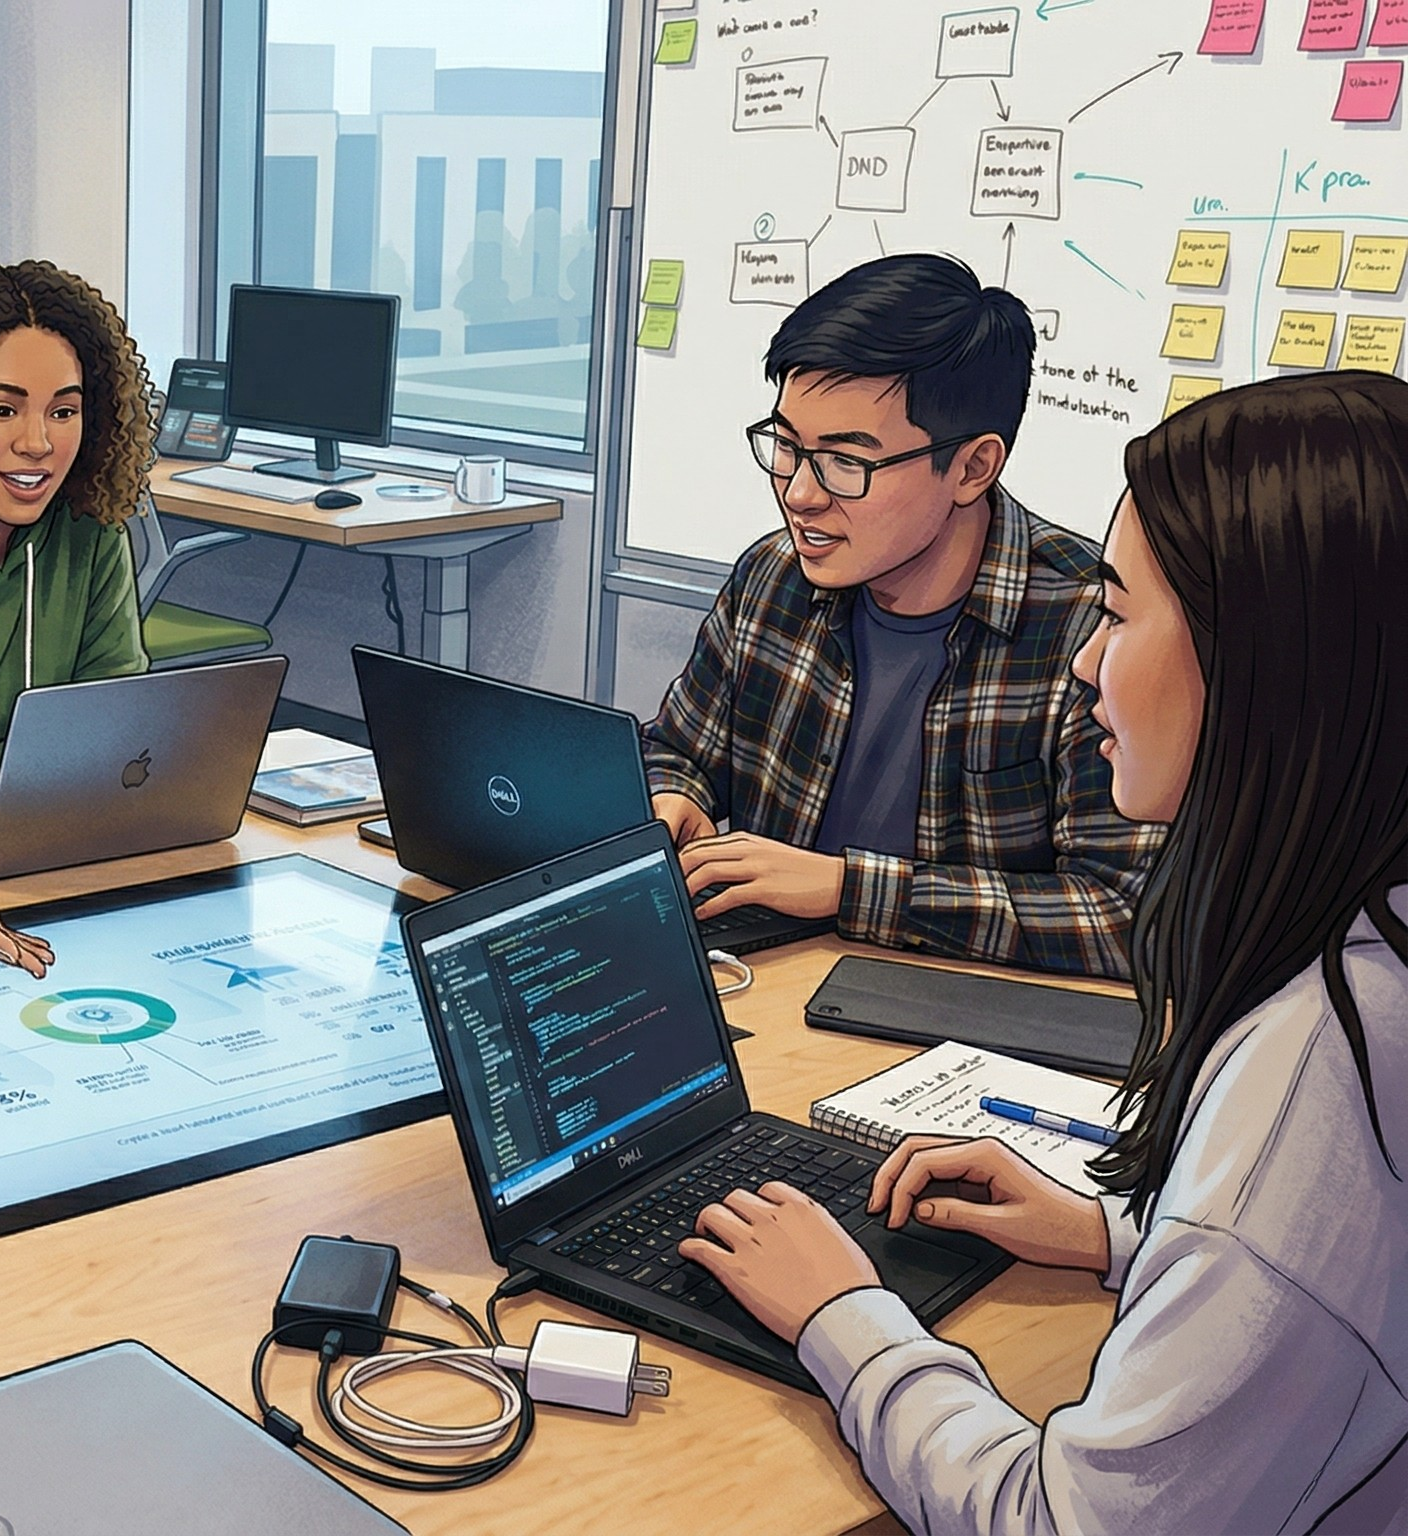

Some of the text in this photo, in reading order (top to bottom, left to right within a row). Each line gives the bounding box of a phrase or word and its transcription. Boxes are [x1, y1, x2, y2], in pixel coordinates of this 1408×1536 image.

[847, 156, 888, 177] DND
[1040, 359, 1076, 380] tone
[1106, 366, 1139, 393] the
